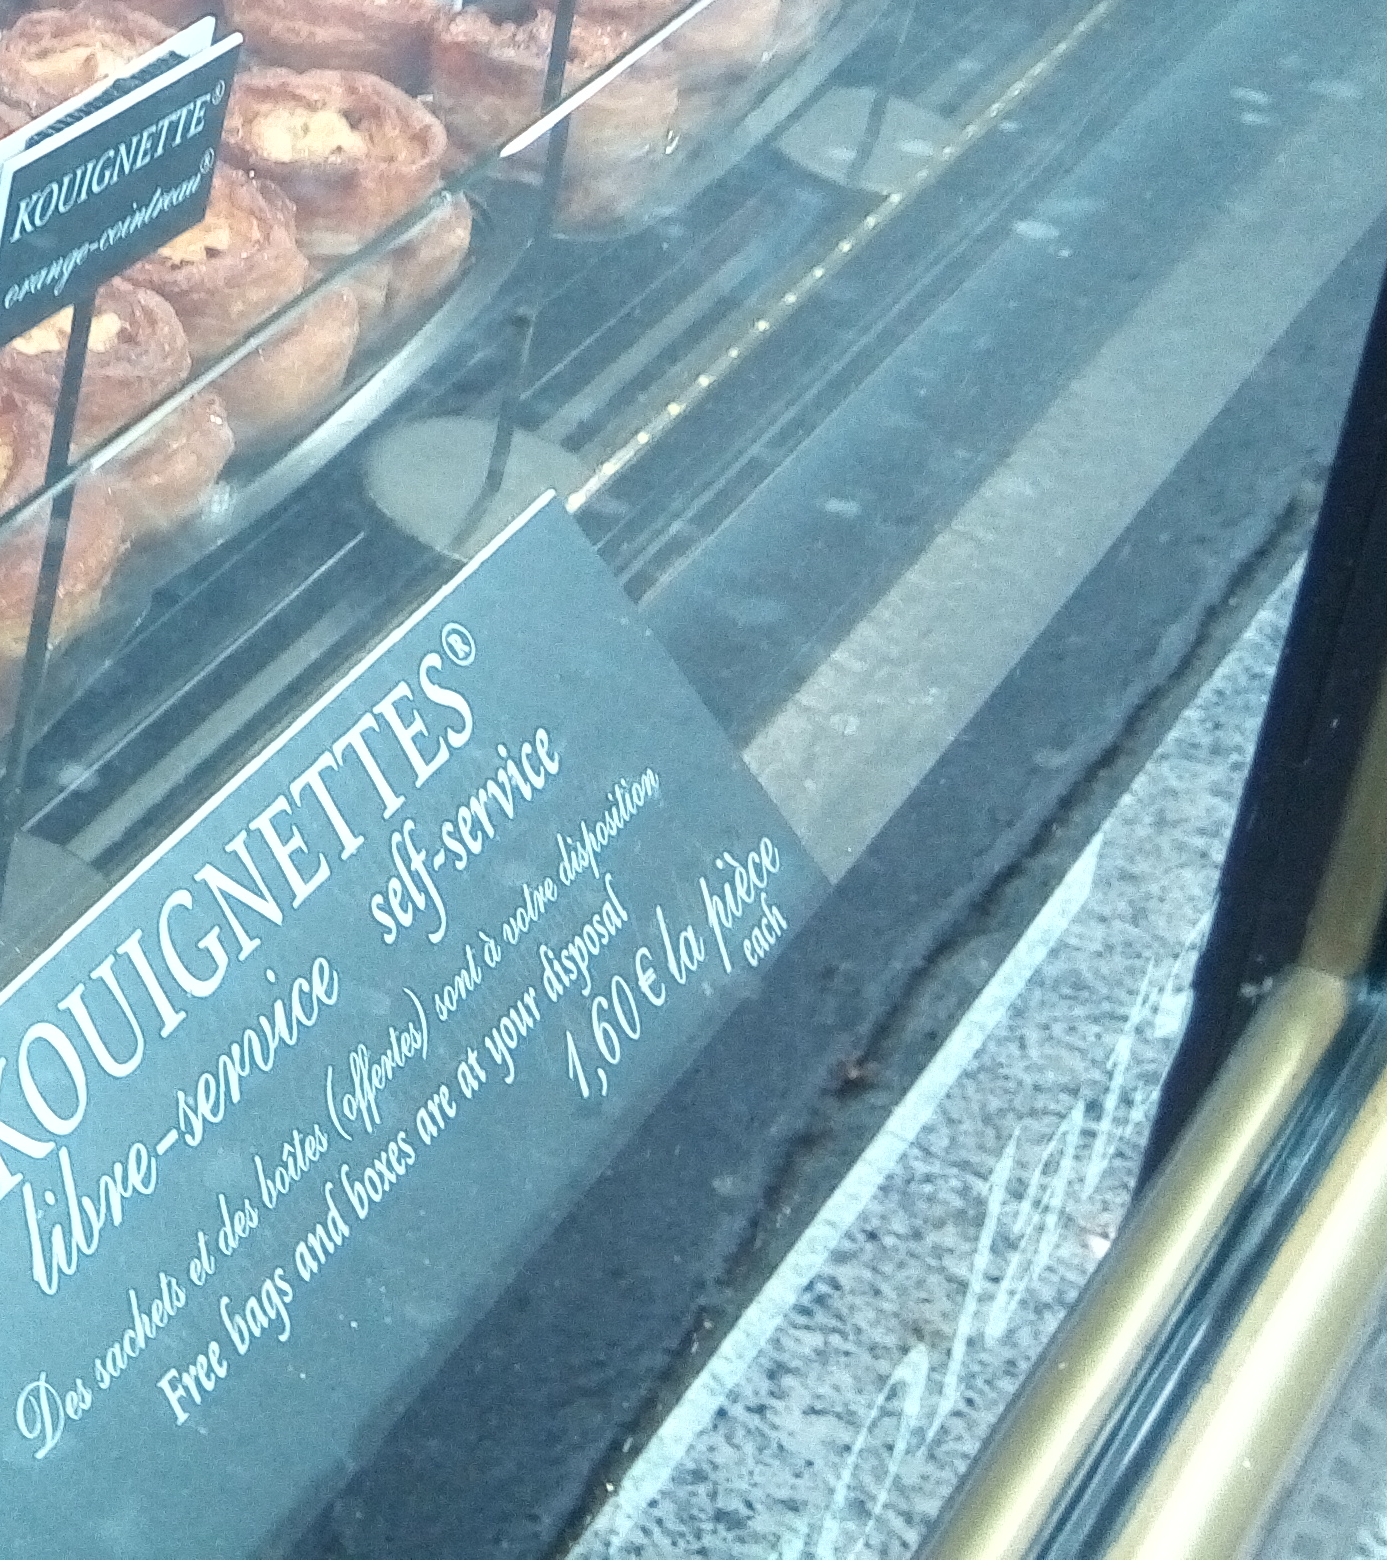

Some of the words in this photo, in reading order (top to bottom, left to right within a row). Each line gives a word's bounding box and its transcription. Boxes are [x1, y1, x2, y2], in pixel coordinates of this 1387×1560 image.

[16, 1371, 93, 1460] Des
[95, 1272, 187, 1390] sachets
[189, 1231, 215, 1287] et
[218, 1193, 260, 1256] des
[254, 1124, 329, 1209] boîtes
[326, 987, 428, 1140] (offertes)
[434, 944, 483, 1022] sont
[479, 931, 502, 968] à
[503, 878, 558, 945] votre
[558, 768, 660, 886] disposition
[23, 956, 339, 1296] libre-service
[371, 728, 559, 944] self-service
[157, 1340, 228, 1426] Free
[220, 1267, 294, 1355] bags
[294, 1182, 350, 1282] and
[340, 1130, 416, 1220] boxes
[416, 1084, 457, 1146] are
[456, 1046, 487, 1100] at
[484, 986, 541, 1085] your
[542, 873, 628, 1003] disposal
[657, 905, 705, 985] la
[699, 836, 781, 974] pièce
[743, 892, 788, 967] each
